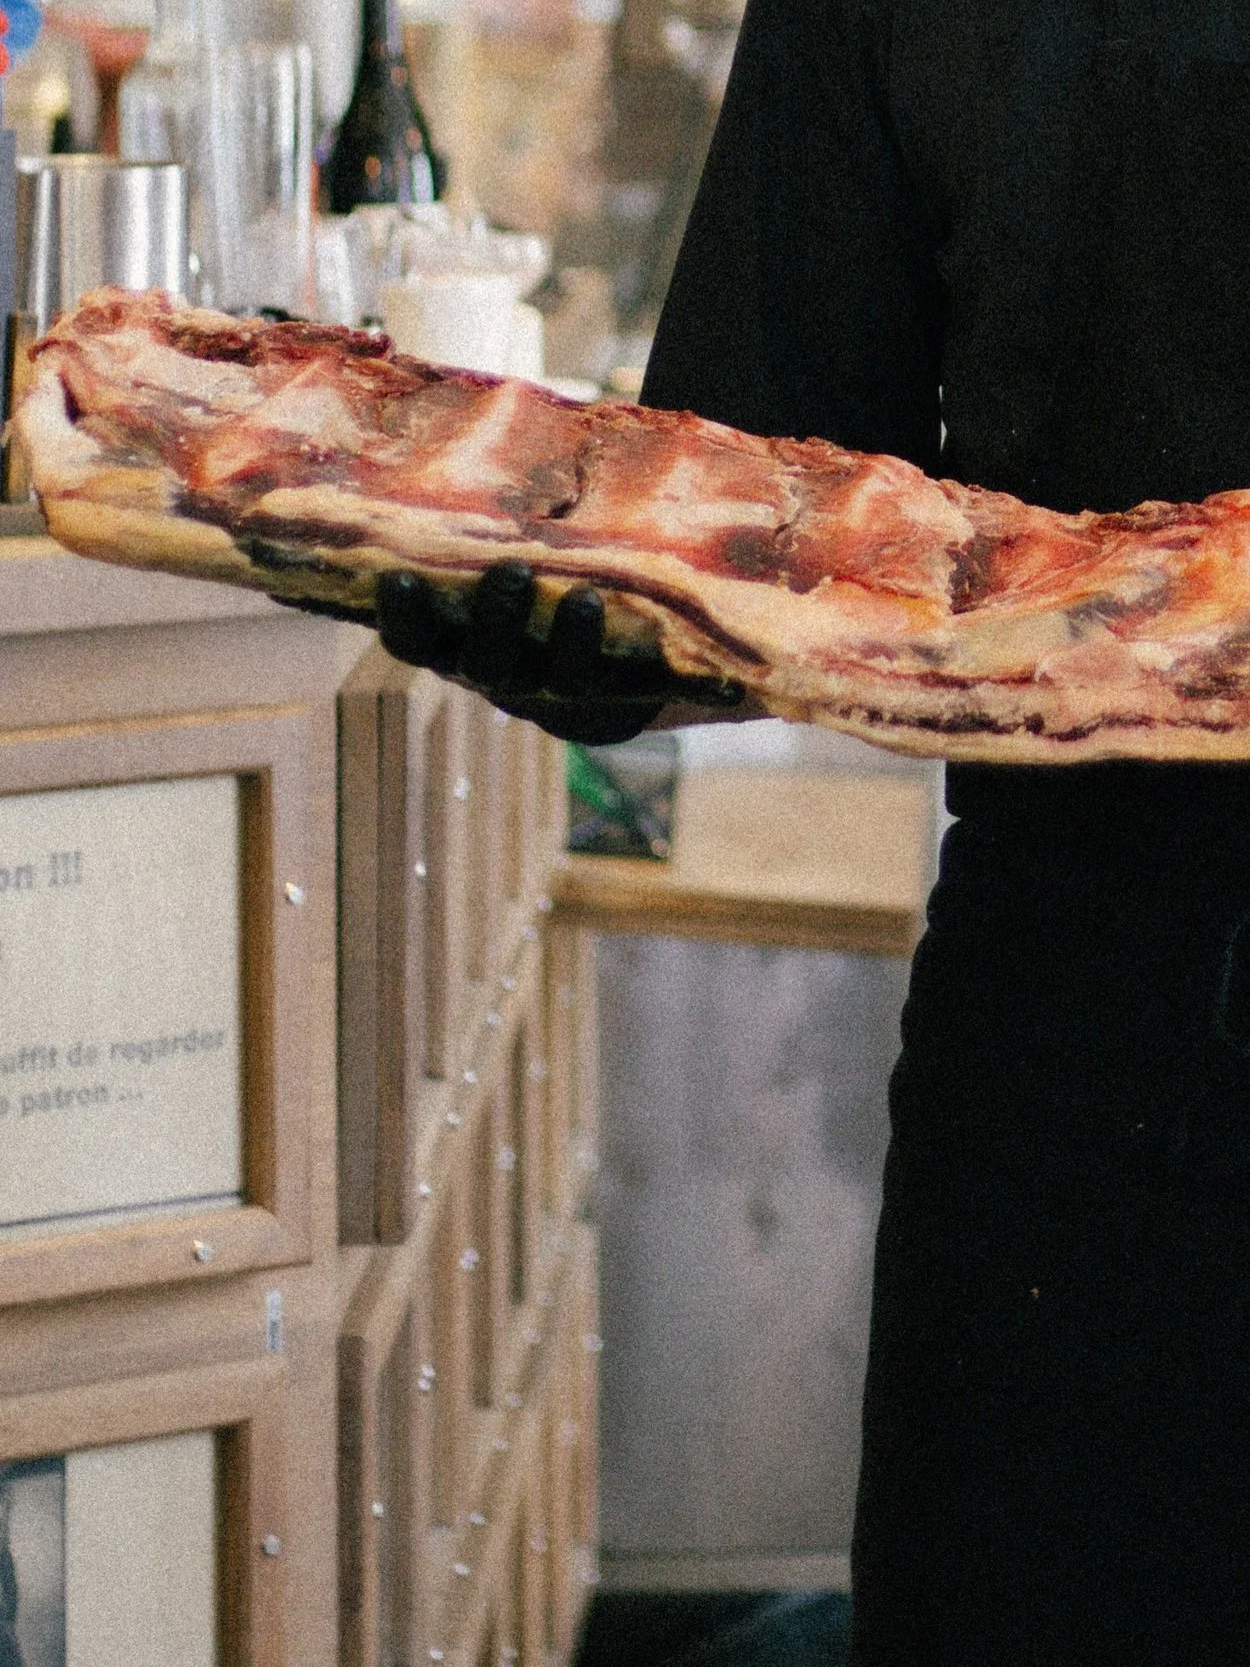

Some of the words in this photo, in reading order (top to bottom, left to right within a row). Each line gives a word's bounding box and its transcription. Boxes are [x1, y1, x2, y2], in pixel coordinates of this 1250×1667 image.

[66, 1040, 99, 1067] de
[110, 1029, 224, 1064] regarder
[20, 1085, 109, 1117] patron
